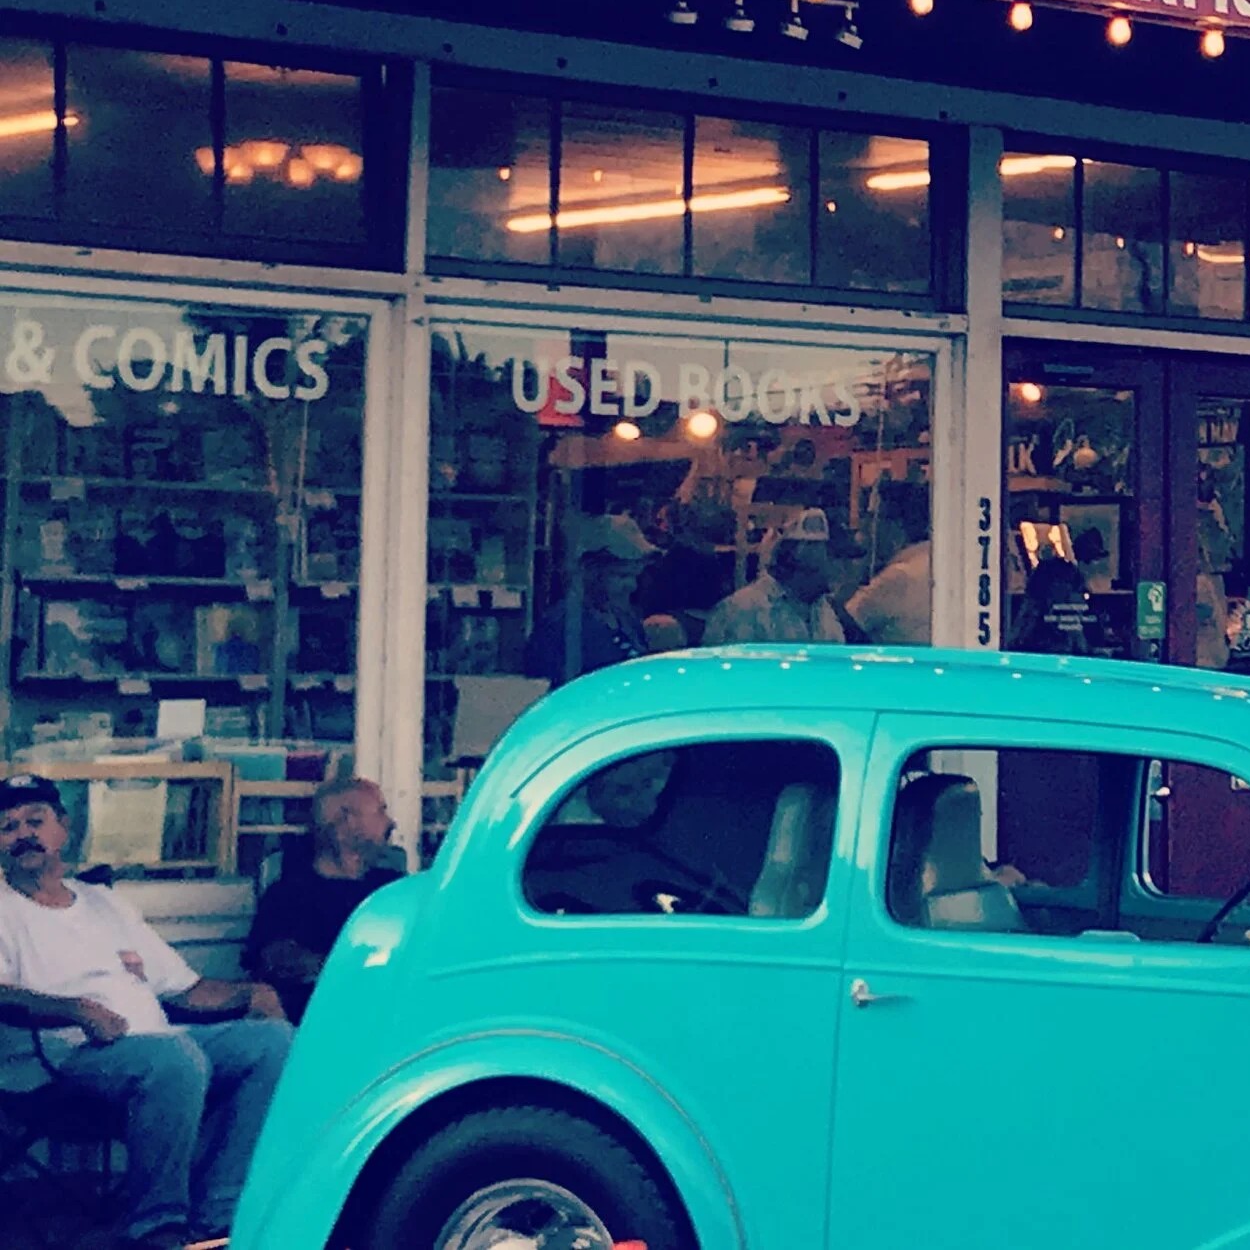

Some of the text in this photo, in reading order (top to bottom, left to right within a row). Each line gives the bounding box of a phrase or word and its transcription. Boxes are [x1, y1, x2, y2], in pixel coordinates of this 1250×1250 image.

[5, 320, 330, 400] & COMICS
[511, 355, 862, 427] USED BOOKS
